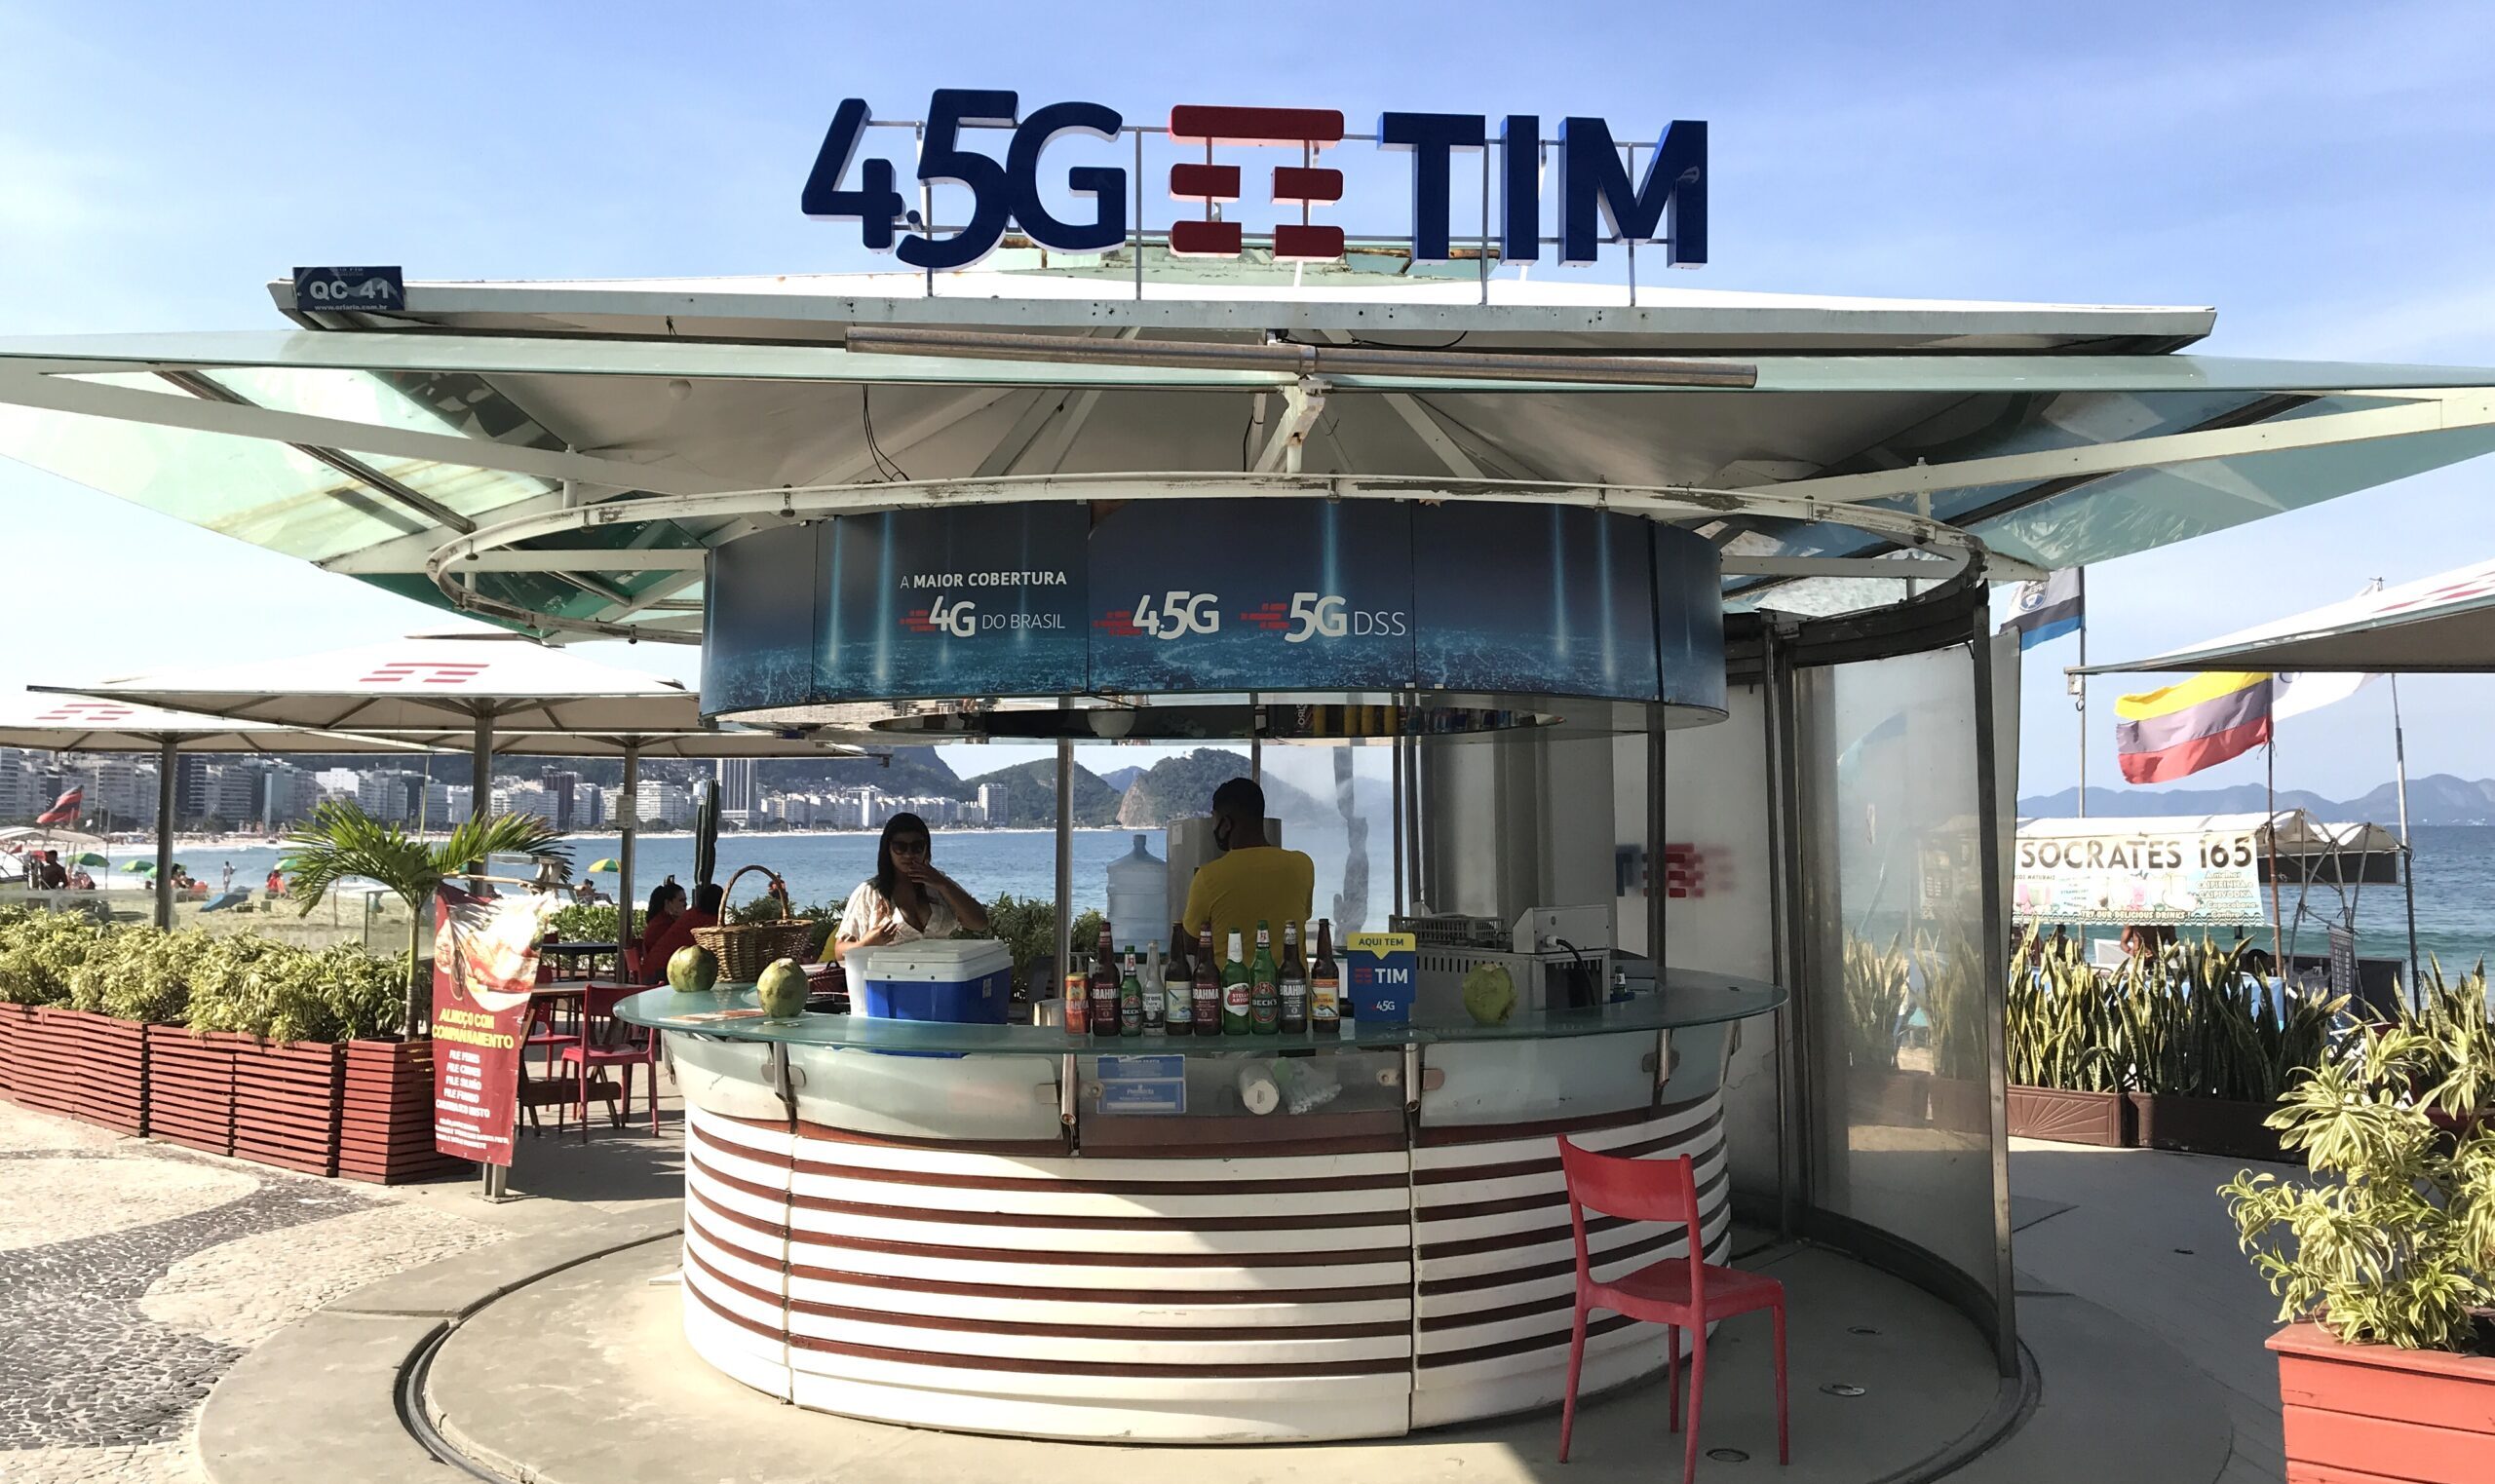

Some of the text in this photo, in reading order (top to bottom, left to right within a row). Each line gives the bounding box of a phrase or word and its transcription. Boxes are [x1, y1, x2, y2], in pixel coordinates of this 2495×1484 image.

[1377, 111, 1708, 270] TIM
[900, 571, 1067, 590] A MAIOR COBERTURA
[929, 595, 1065, 637] 4G DO BRASIL
[1284, 591, 1406, 643] 5G DSS
[2020, 836, 2252, 869] SOCRATES 165
[1359, 937, 1404, 946] AQUI TEM
[1375, 968, 1408, 984] TIM
[439, 1008, 495, 1029] ALMOÇO COM
